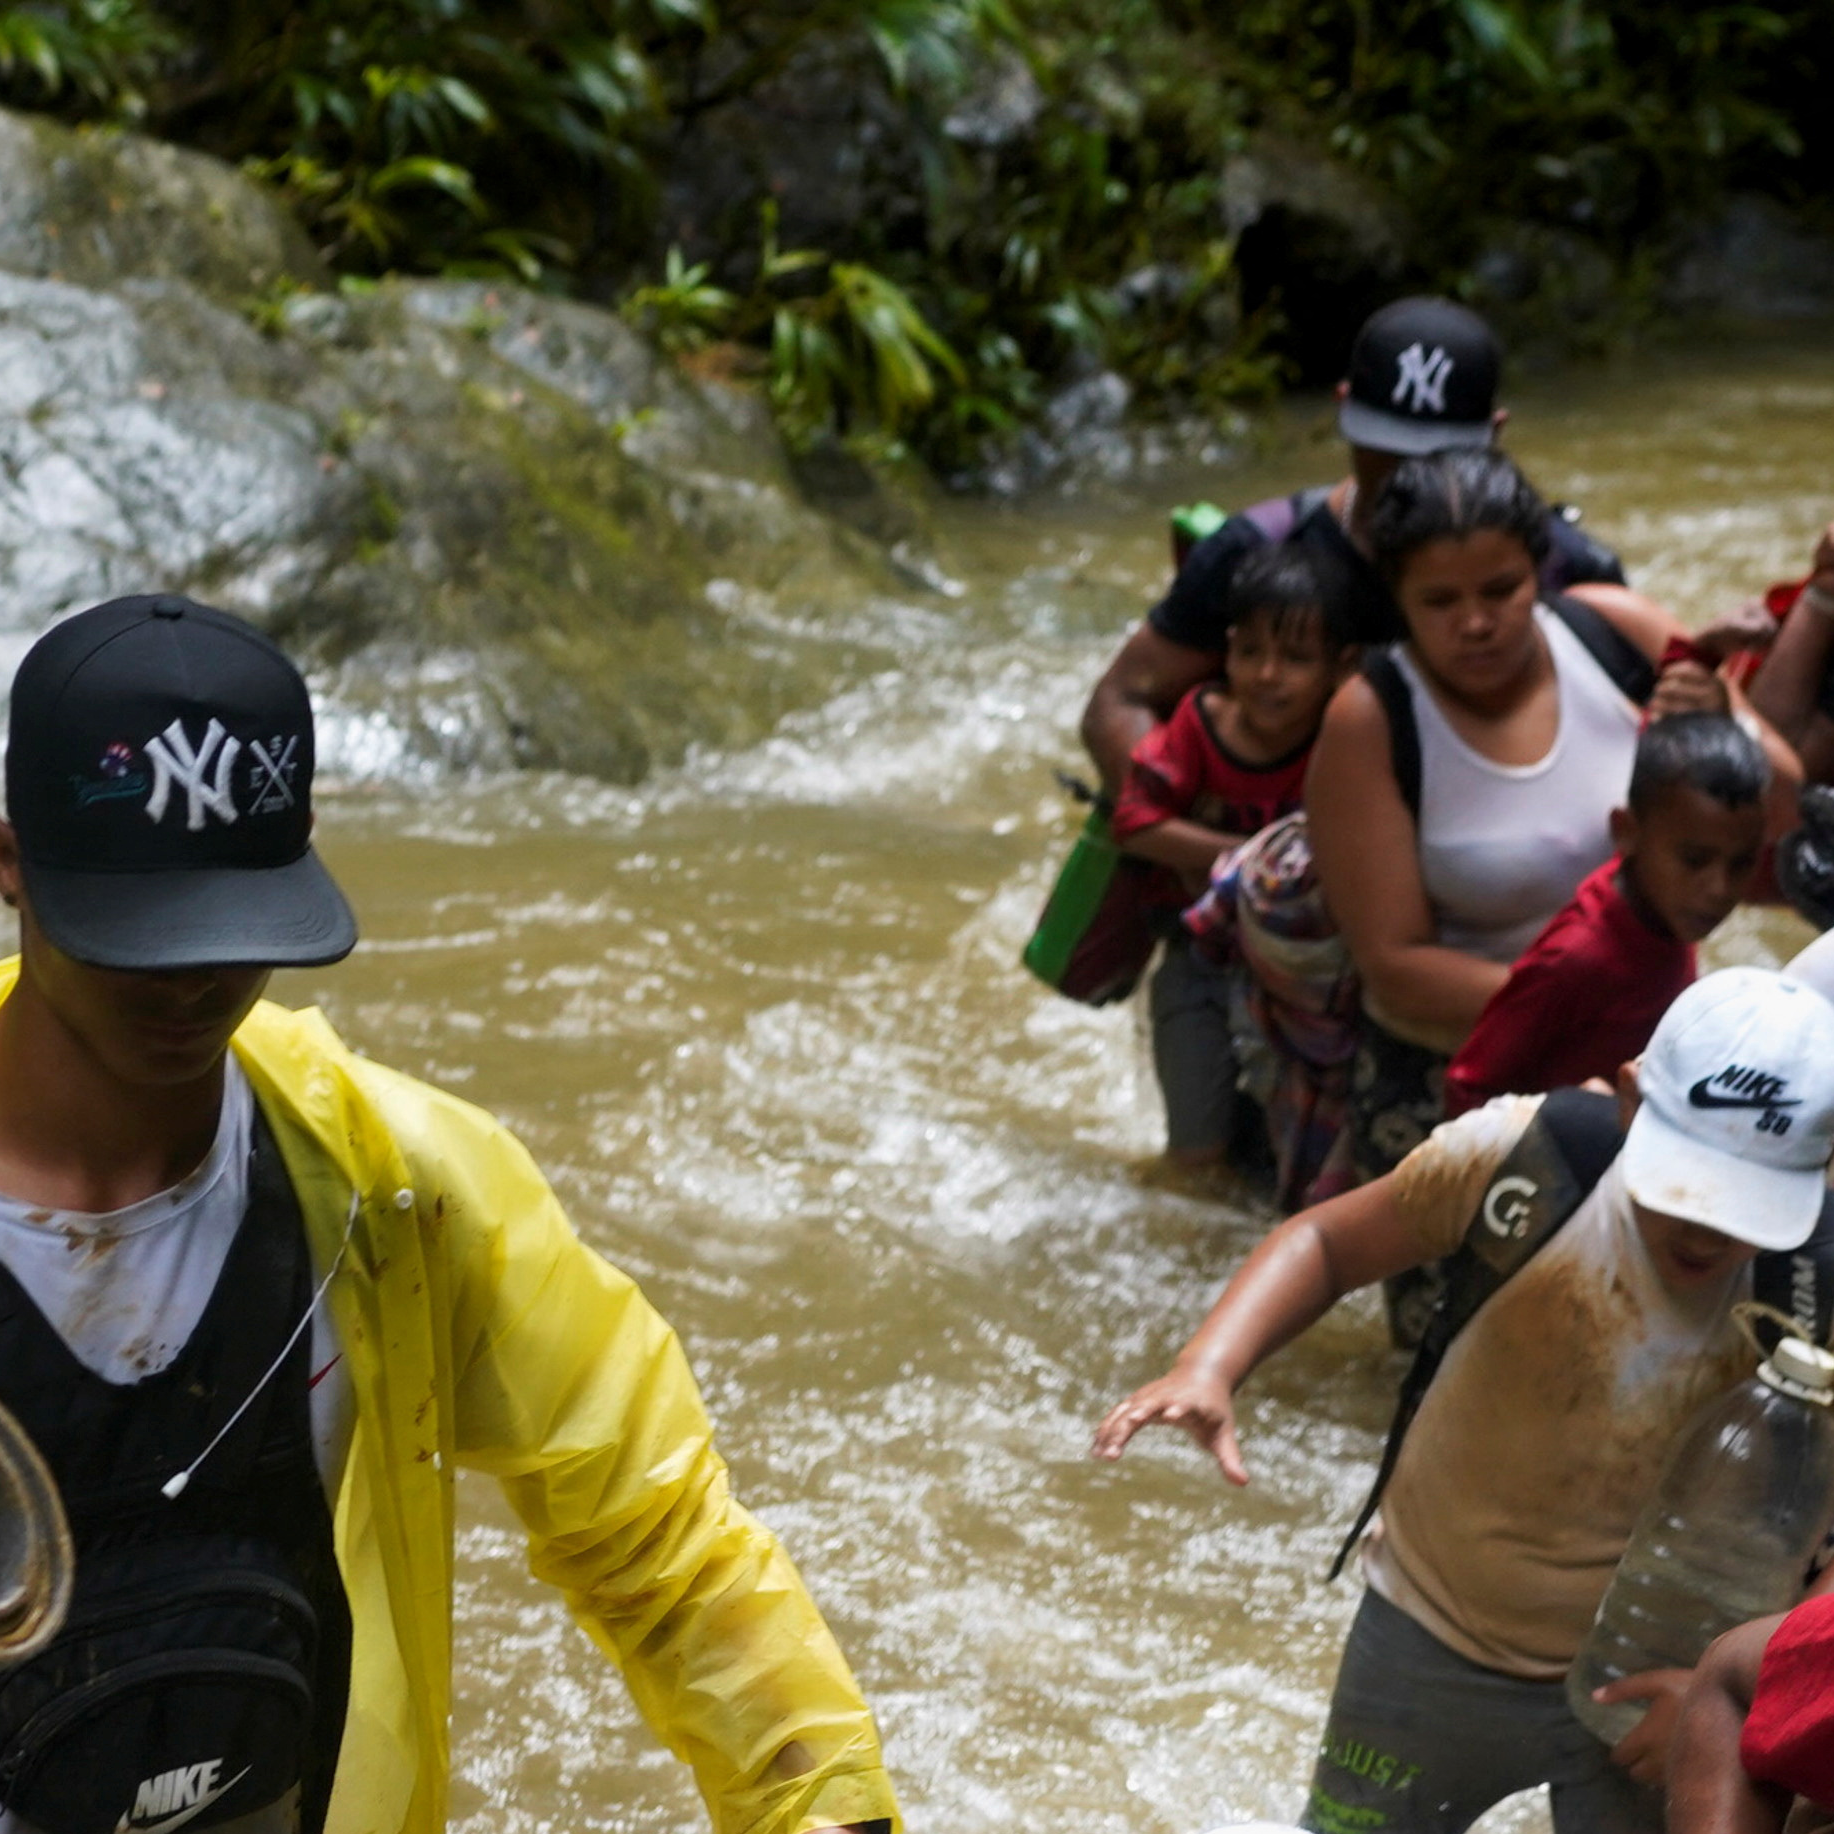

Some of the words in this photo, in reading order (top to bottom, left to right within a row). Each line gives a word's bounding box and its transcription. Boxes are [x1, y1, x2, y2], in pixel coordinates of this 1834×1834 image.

[1390, 341, 1455, 416] NY
[143, 716, 241, 832] NY
[1713, 1063, 1789, 1102] NIKE
[129, 1757, 224, 1820] NIKE
